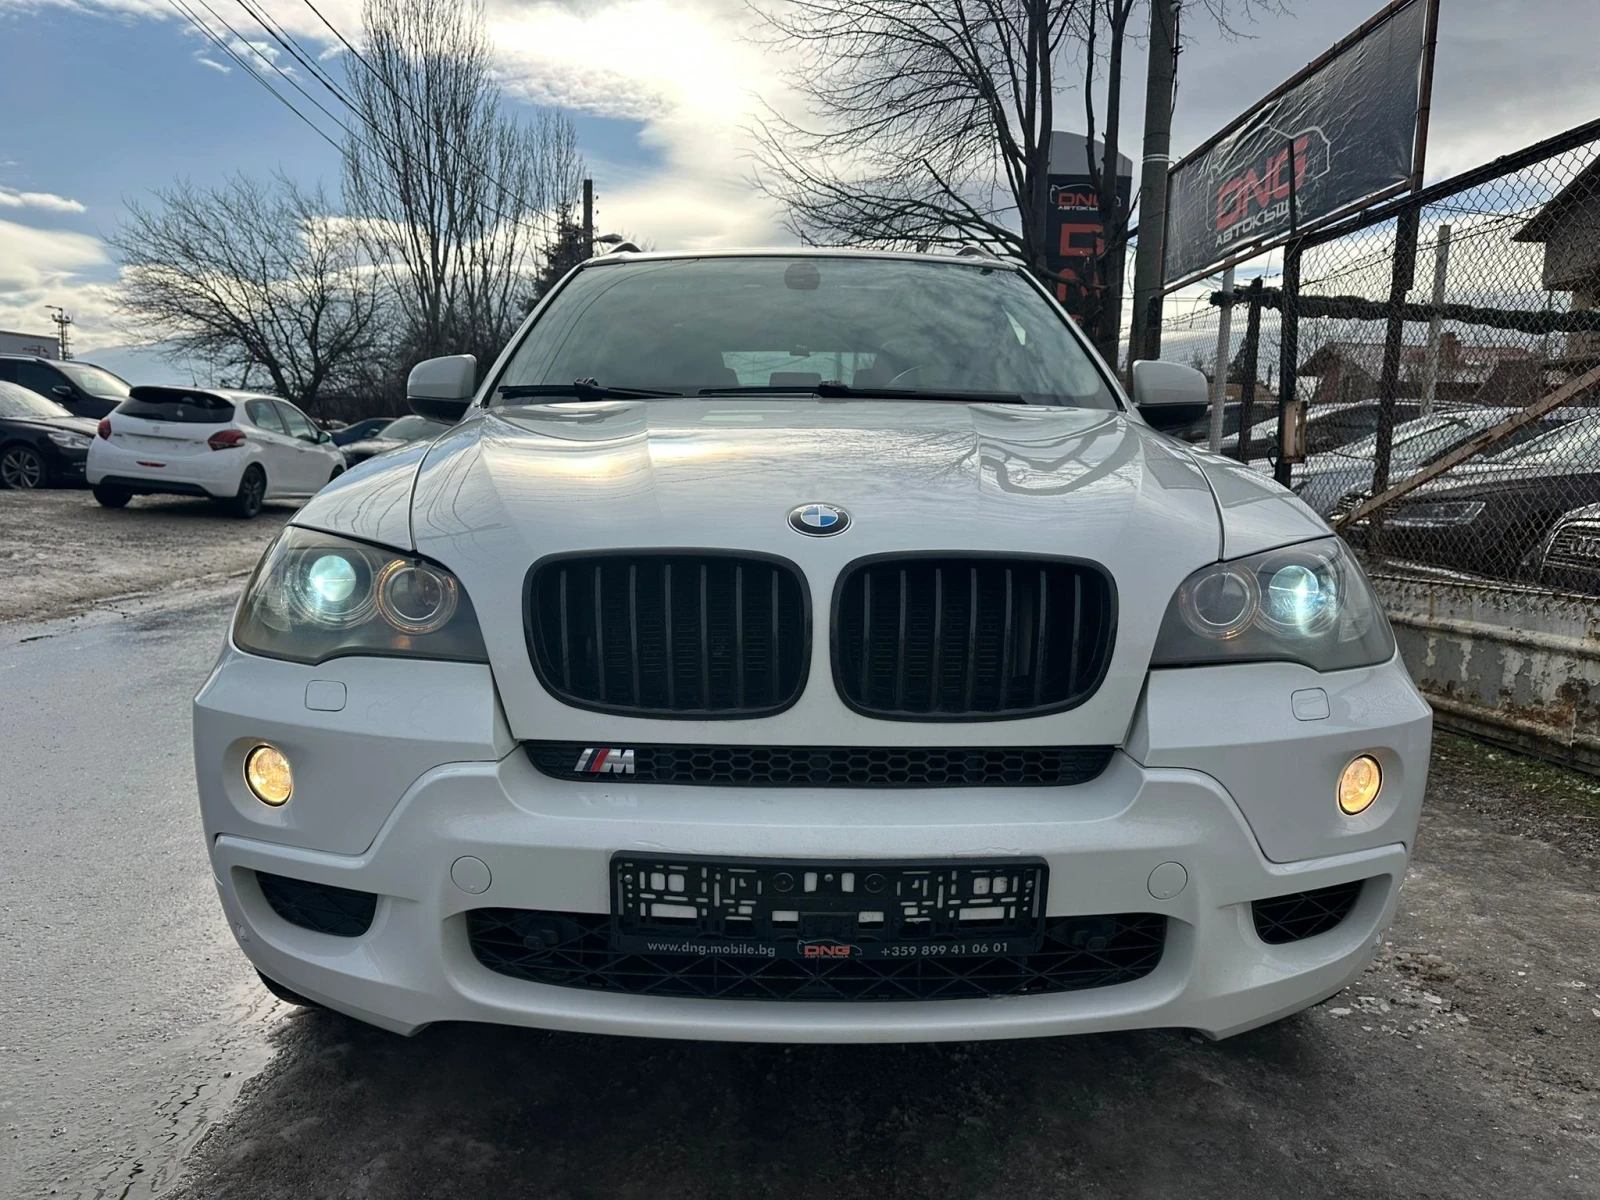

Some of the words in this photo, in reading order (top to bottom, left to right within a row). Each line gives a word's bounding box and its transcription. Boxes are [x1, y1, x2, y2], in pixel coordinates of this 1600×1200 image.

[1216, 134, 1310, 231] DNG
[647, 941, 776, 957] www.dng.mobile.bg
[804, 945, 850, 956] DNG
[881, 945, 917, 956] +359
[921, 945, 947, 955] 899
[950, 944, 966, 954] 41
[971, 943, 989, 953] 06
[992, 942, 1008, 952] 01
